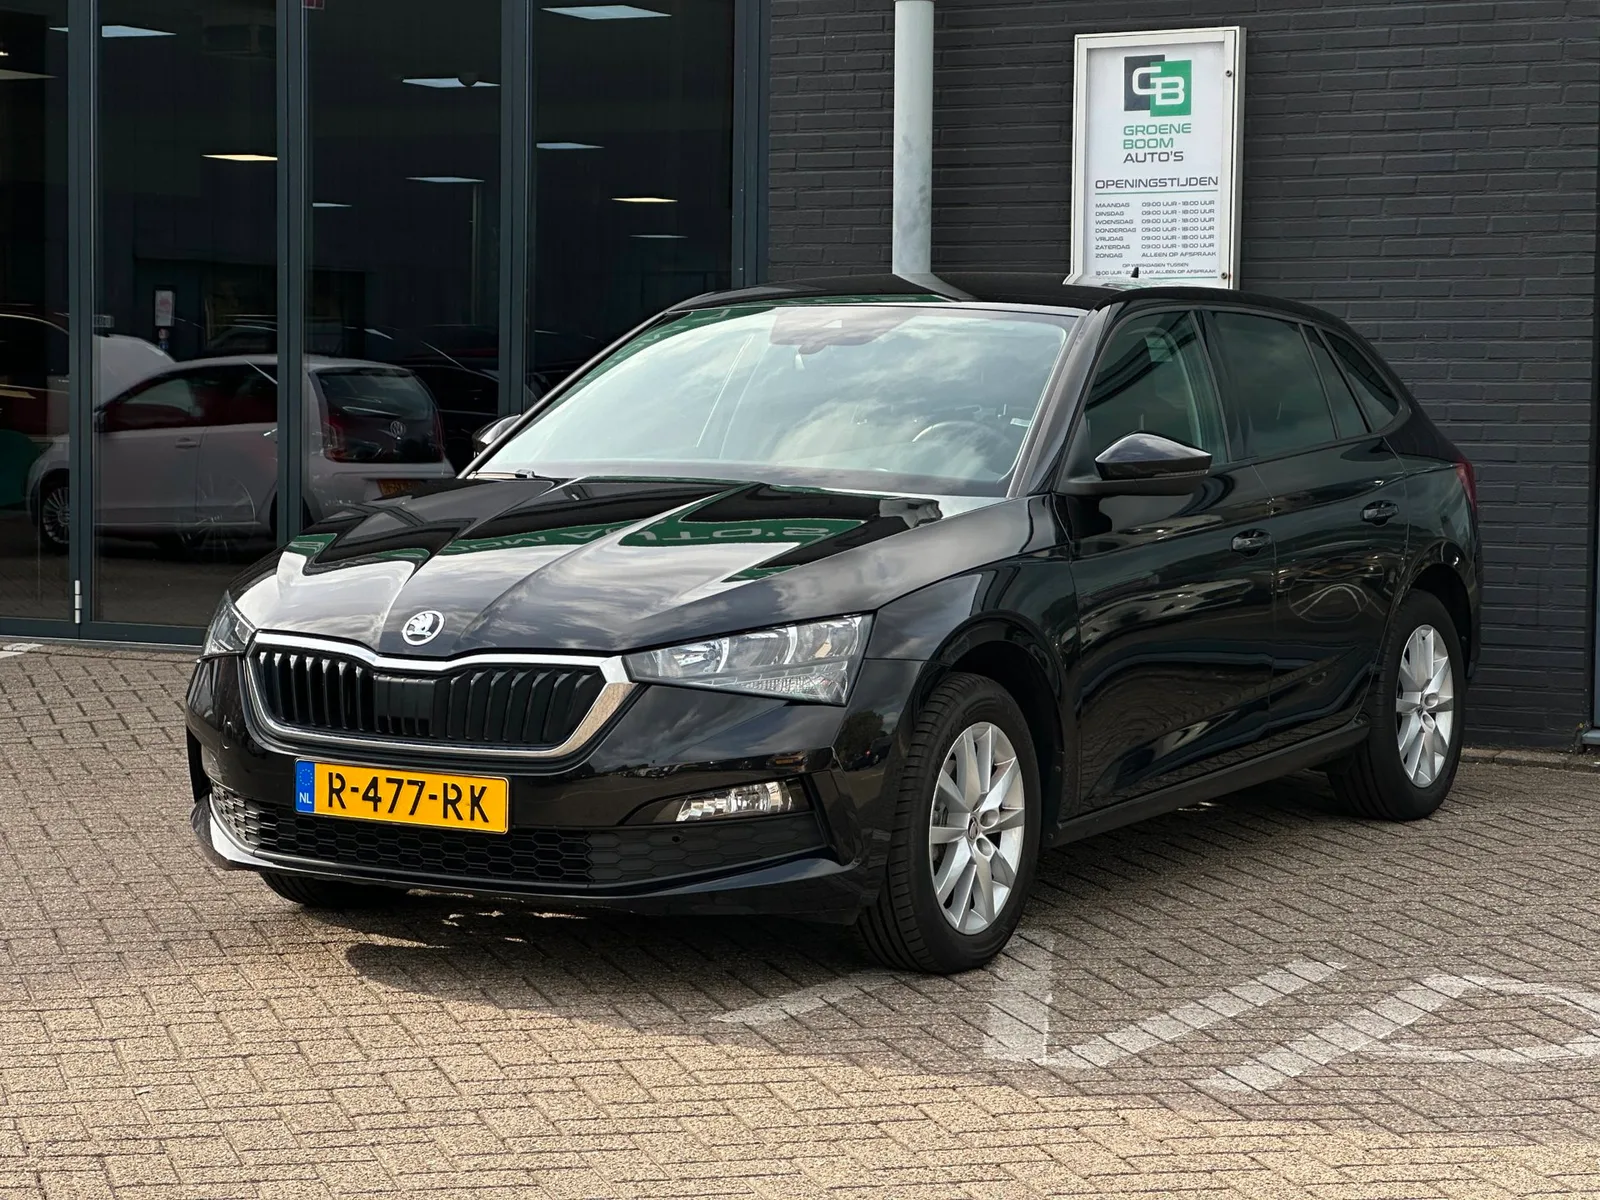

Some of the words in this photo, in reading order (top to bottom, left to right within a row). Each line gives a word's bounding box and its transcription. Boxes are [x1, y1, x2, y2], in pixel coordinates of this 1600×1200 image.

[1123, 123, 1192, 136] GROENE
[1123, 137, 1174, 149] BOOM
[1123, 151, 1184, 163] AUTO'S
[1095, 176, 1218, 188] OPENINGSTIJDEN
[299, 792, 312, 804] NL
[327, 771, 490, 824] R-477-RK
